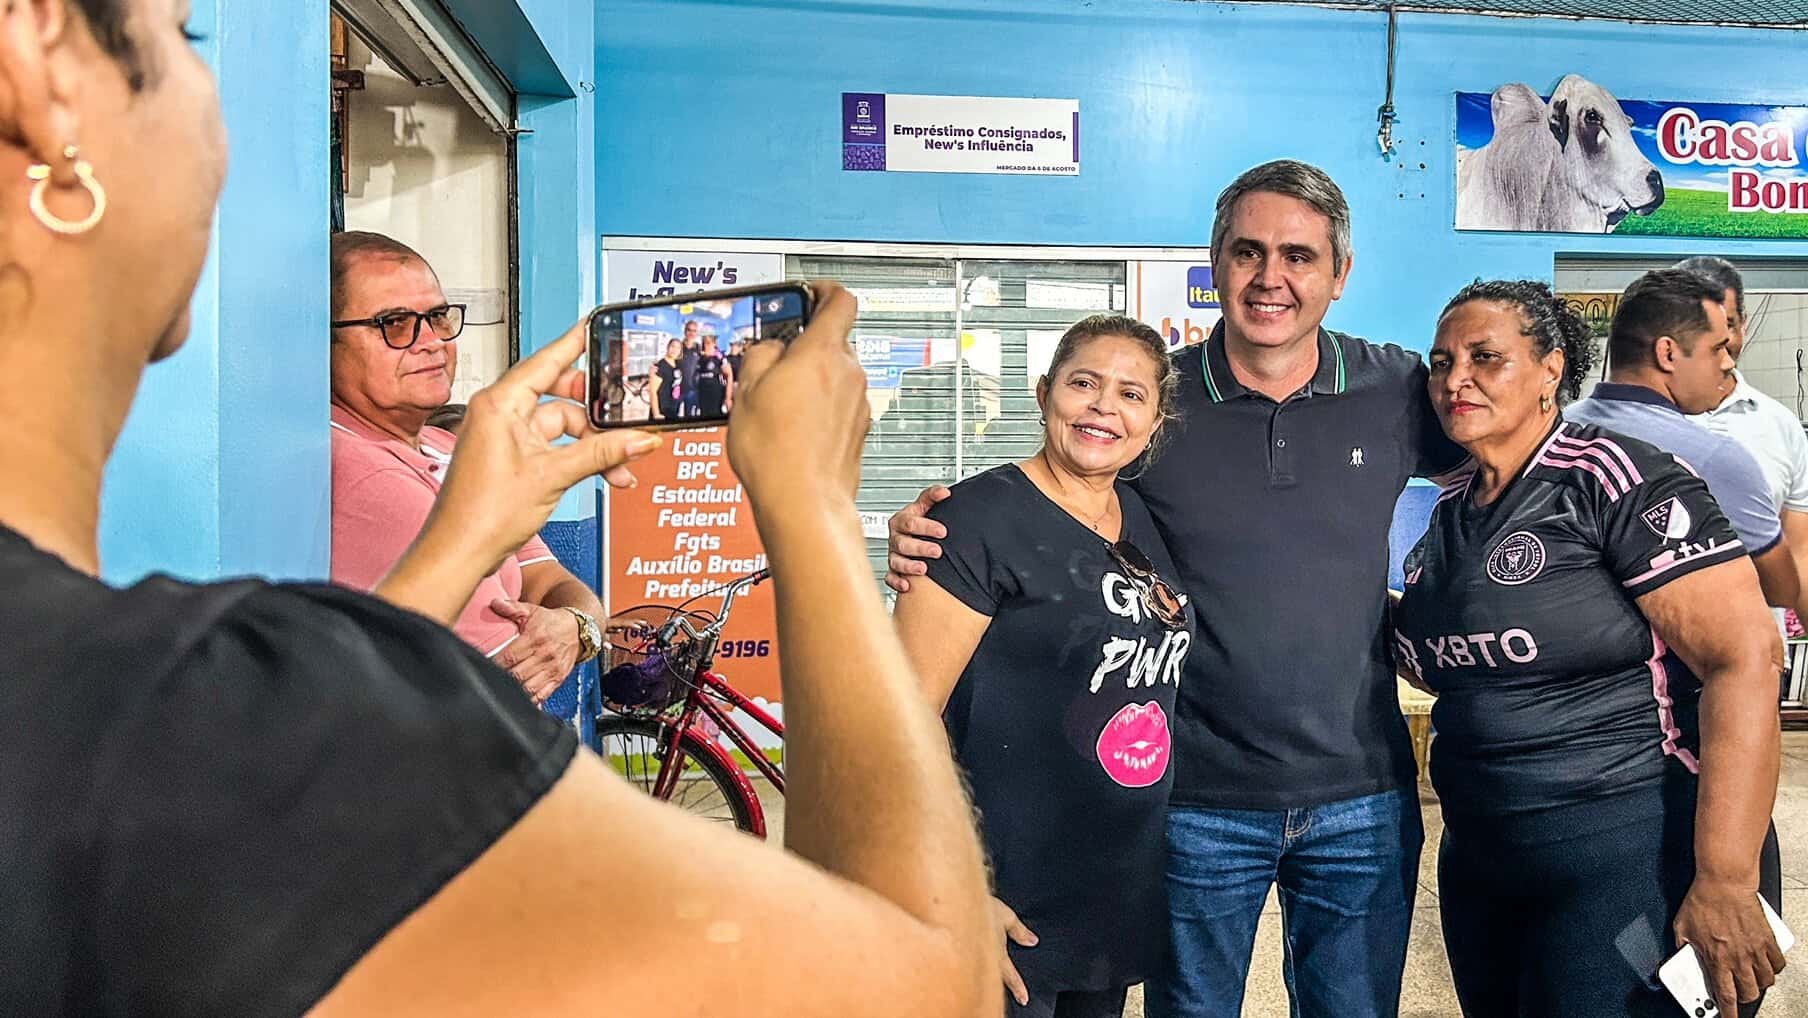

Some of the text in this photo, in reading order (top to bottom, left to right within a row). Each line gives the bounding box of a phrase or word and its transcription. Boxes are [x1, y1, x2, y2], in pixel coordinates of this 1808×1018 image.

[893, 124, 974, 138] Empréstimo
[978, 126, 1067, 141] Consignados,
[1662, 113, 1792, 162] Casa
[924, 139, 1034, 152] New's Influência
[652, 260, 738, 284] New's
[672, 438, 722, 456] Loas
[676, 461, 720, 480] BPC
[652, 483, 742, 503] Estadual
[657, 508, 737, 528] Federal
[1647, 505, 1668, 521] MLS
[673, 532, 721, 556] Fgts
[626, 552, 768, 575] Auxílio Brasil
[645, 578, 750, 599] Prefeitua
[1425, 628, 1538, 668] XBTO
[1089, 630, 1191, 694] PWR
